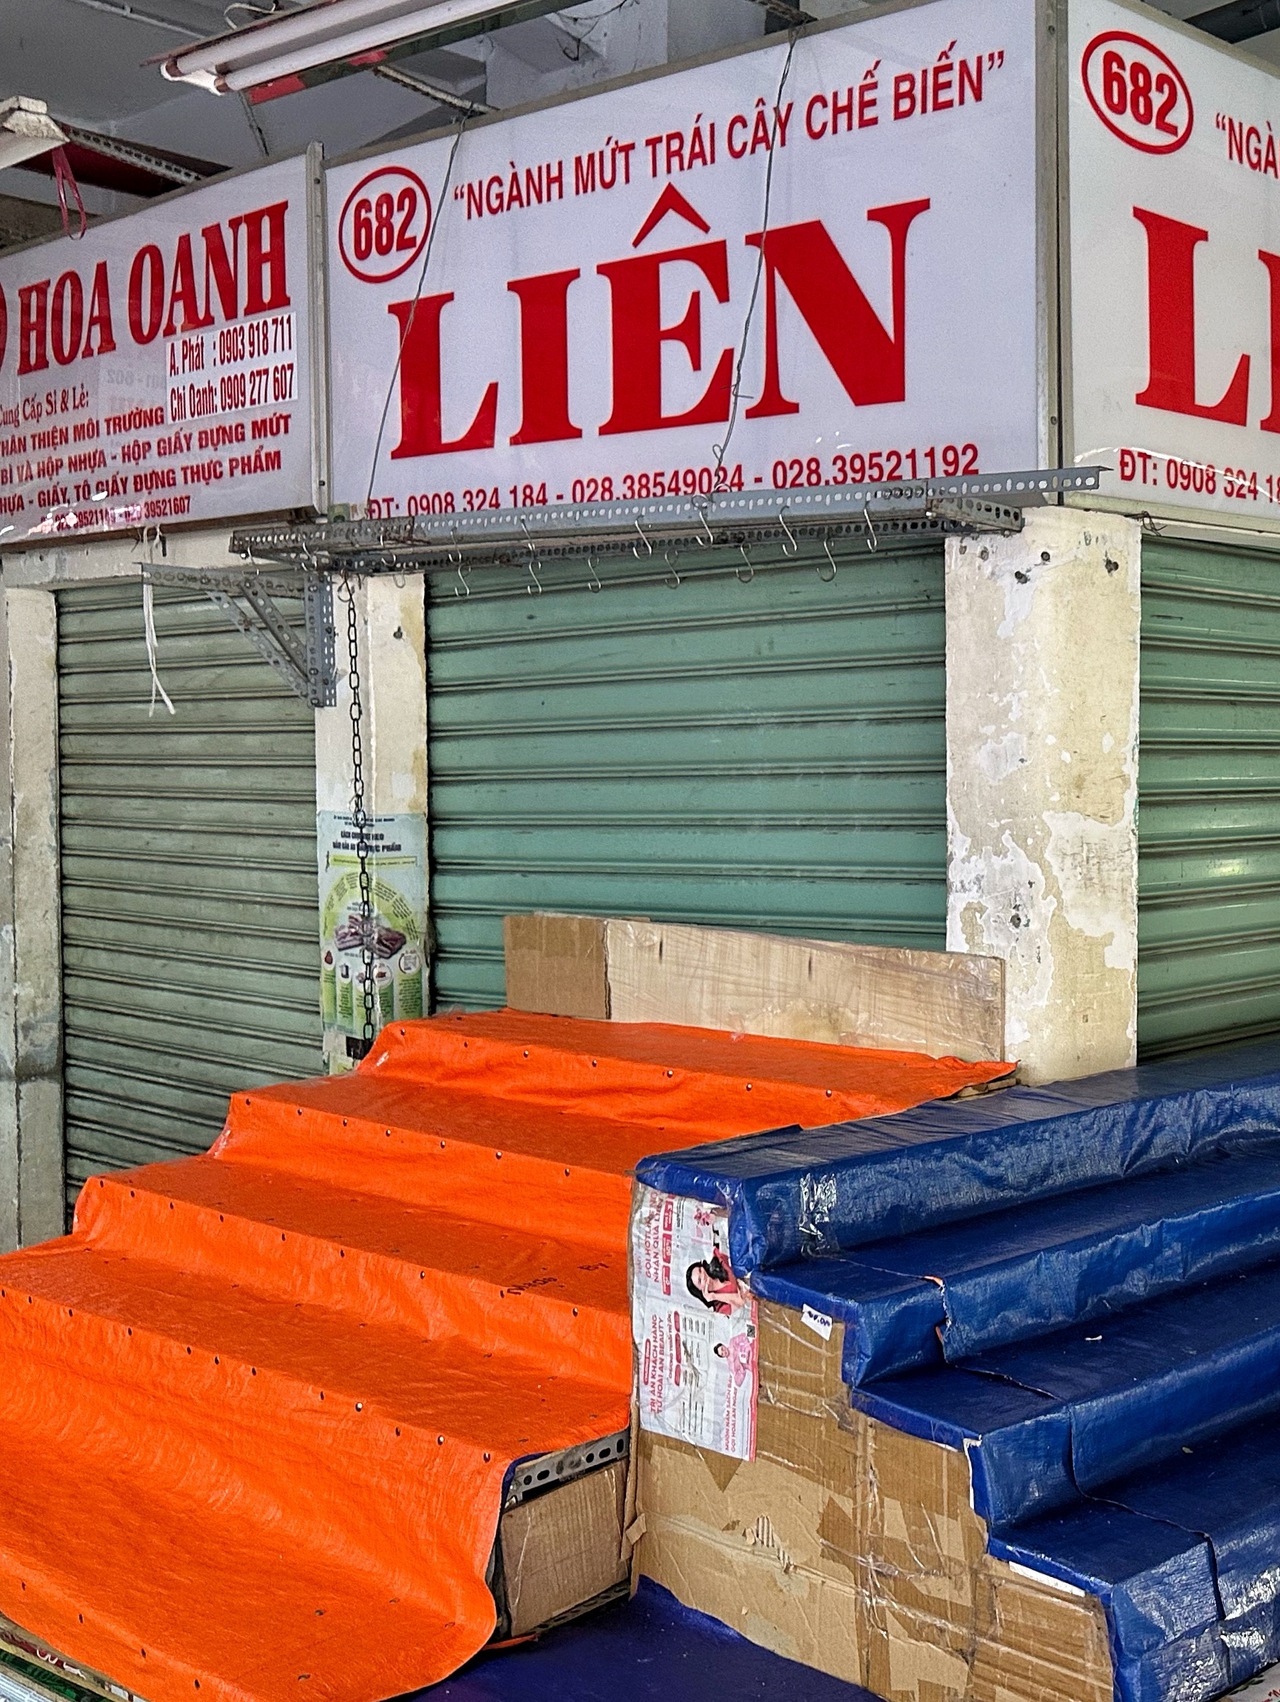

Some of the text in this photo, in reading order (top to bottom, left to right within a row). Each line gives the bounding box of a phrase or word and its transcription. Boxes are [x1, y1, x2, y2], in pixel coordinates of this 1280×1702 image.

[573, 131, 636, 197] MỨT
[645, 117, 717, 179] TRÁI
[727, 97, 795, 160] CÂY
[805, 60, 879, 141] CHẾ
[1102, 49, 1180, 139] 682
[353, 186, 419, 261] 682
[17, 200, 292, 376] HOA OANH
[388, 182, 931, 461] LIÊN
[182, 334, 205, 375] Phát
[219, 324, 245, 367] 0903
[248, 319, 269, 359] 918
[272, 314, 292, 354] 711
[23, 392, 43, 423] Cấp
[60, 388, 69, 414] &
[220, 372, 246, 413] 0909
[249, 367, 269, 406] 277
[273, 362, 294, 402] 607
[0, 405, 165, 458] HÂN THIỆN MÔI TRƯỜNG
[17, 458, 33, 484] VÀ
[37, 455, 64, 480] HỘP
[67, 448, 108, 474] NHỰA
[121, 438, 152, 466] HỘP
[157, 427, 193, 458] GIẤY
[198, 422, 246, 451] ĐỰNG
[251, 412, 292, 441] MỨT
[0, 492, 25, 518] HỰA
[74, 478, 92, 503] TÔ
[133, 467, 177, 495] ĐỰNG
[181, 457, 224, 486] THỰC
[229, 444, 282, 478] PHẨM
[407, 491, 456, 516] 0908
[462, 487, 500, 513] 324
[509, 482, 548, 509] 184
[572, 464, 745, 504] 028.38549024
[772, 443, 980, 490] 028.39521192
[1120, 447, 1159, 488] ĐT:
[1166, 458, 1218, 497] 0908
[1223, 466, 1259, 502] 324
